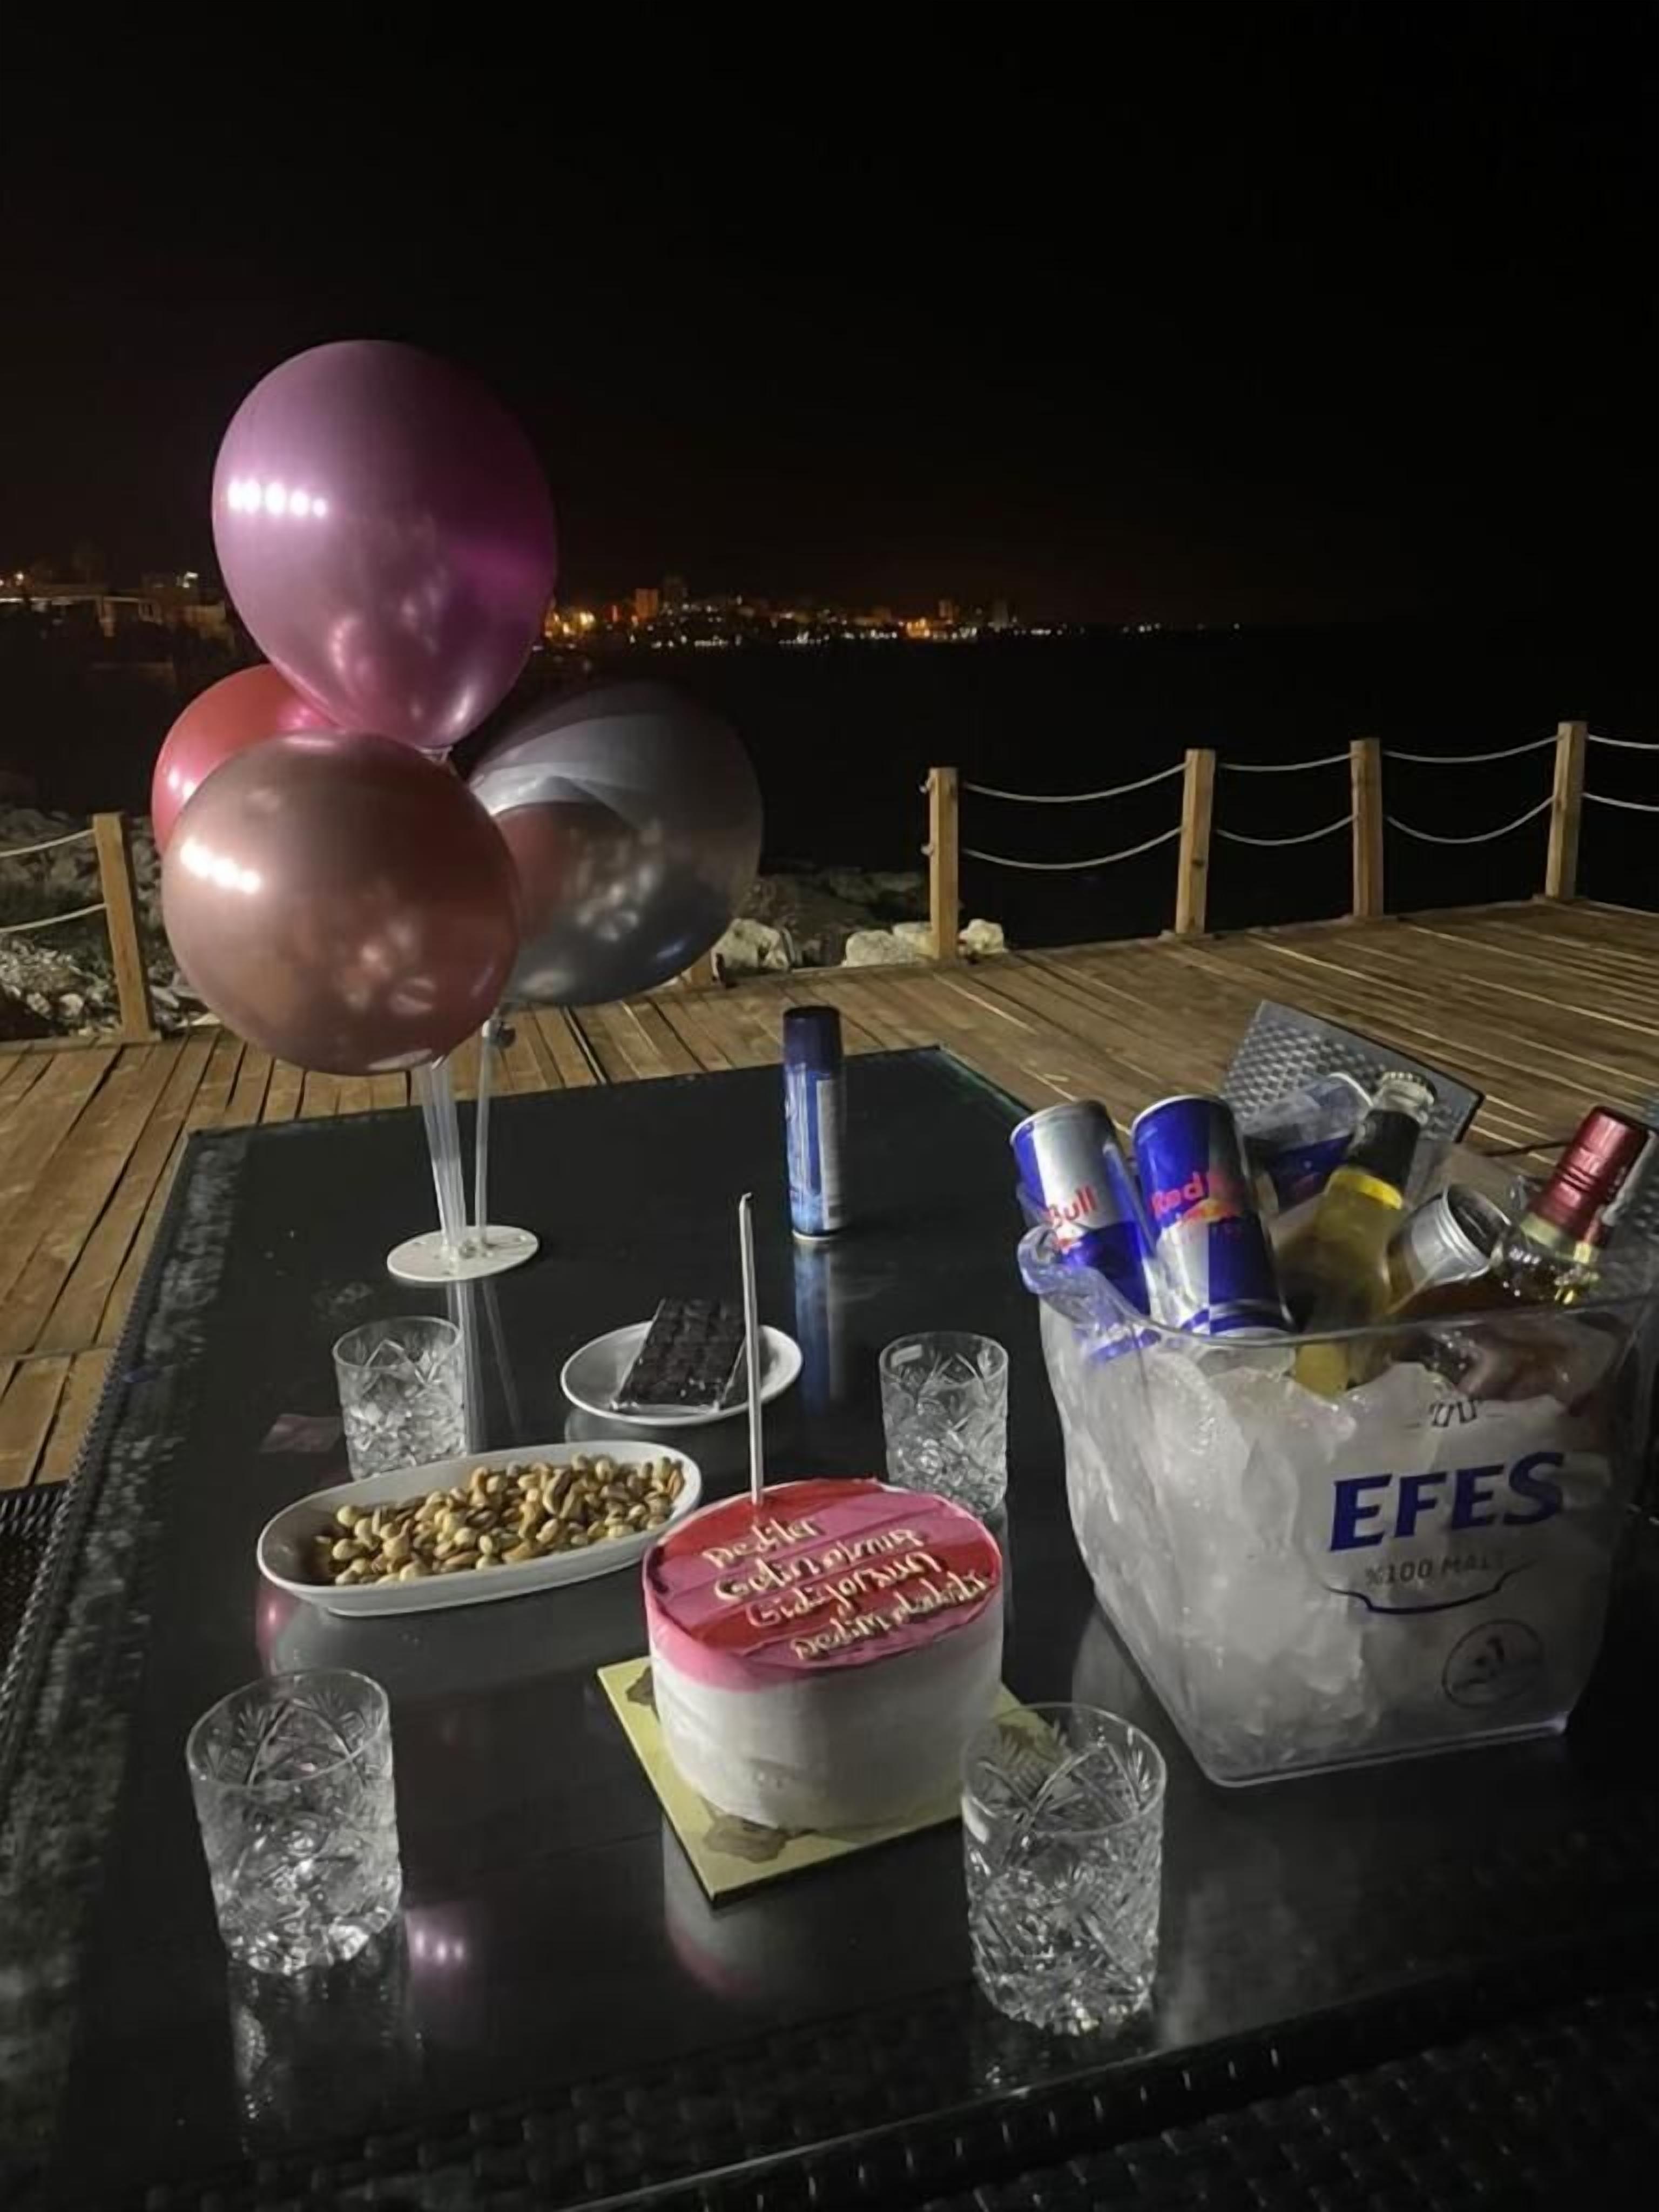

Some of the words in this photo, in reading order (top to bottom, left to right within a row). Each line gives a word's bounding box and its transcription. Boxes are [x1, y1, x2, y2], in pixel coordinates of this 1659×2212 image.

[1046, 1186, 1097, 1228] Bull
[1151, 1170, 1204, 1219] Red
[1330, 1451, 1565, 1552] EFES
[702, 1516, 818, 1568] Dediler
[714, 1557, 820, 1601] Gelin
[1364, 1559, 1433, 1586] %100
[791, 1614, 891, 1660] Dedim
